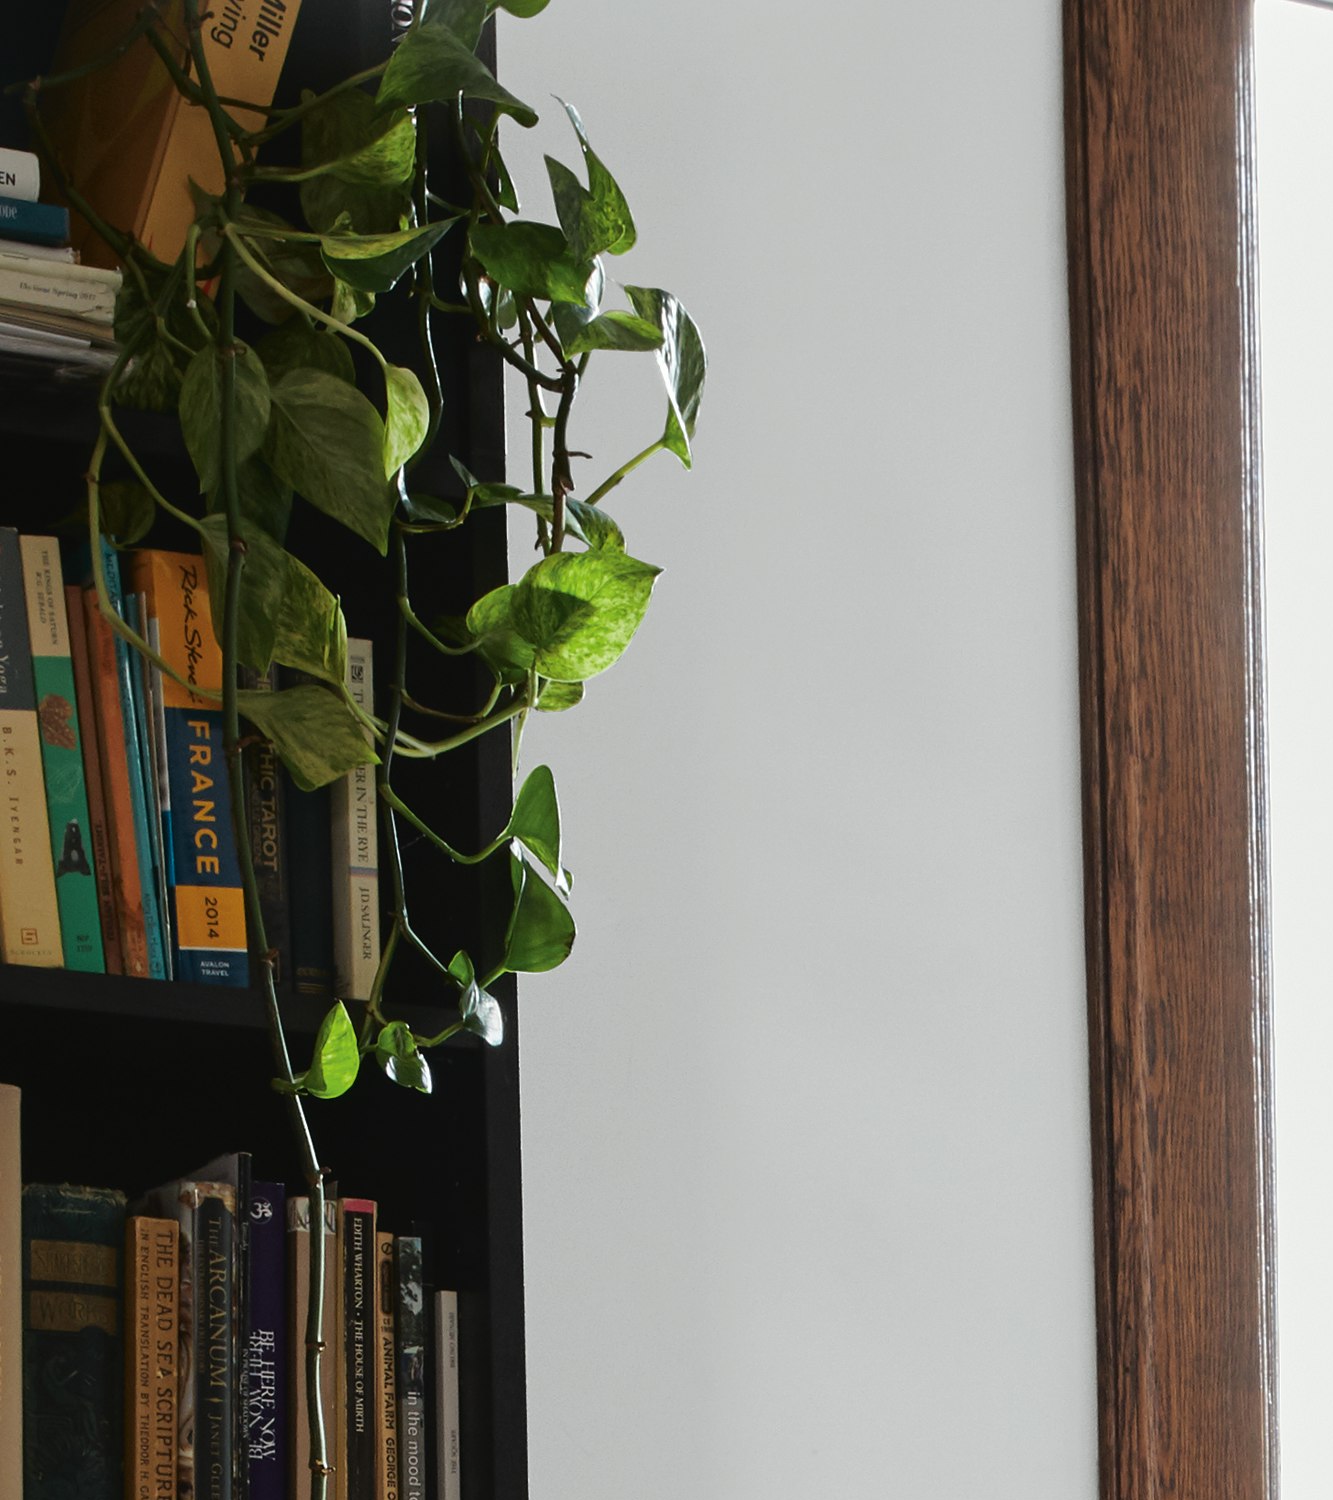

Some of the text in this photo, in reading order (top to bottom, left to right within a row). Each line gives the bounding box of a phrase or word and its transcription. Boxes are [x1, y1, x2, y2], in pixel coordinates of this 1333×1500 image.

[179, 563, 198, 626] Rick
[186, 719, 221, 876] FRANCE
[356, 788, 368, 803] IN
[357, 805, 369, 835] THE
[9, 796, 24, 866] IYENGAR
[261, 795, 279, 873] TAROT
[357, 836, 370, 864] RYE
[204, 895, 219, 939] 2014
[360, 904, 373, 961] SALINGER
[200, 960, 230, 969] AVALON
[200, 968, 229, 978] TRAVEL
[139, 1244, 151, 1301] ENGLISH
[155, 1230, 174, 1269] THE
[353, 1217, 364, 1310] EDITH WHARTON
[155, 1277, 174, 1333] DEAD
[207, 1215, 229, 1389] THE ARCANUM
[139, 1306, 151, 1388] TRANSLATION
[155, 1340, 174, 1379] SEA
[382, 1336, 395, 1390] ANIMAL
[139, 1392, 150, 1407] BY
[258, 1328, 277, 1461] BE HERE NOW
[354, 1319, 365, 1433] THE HOUSE OF MIRTH
[407, 1389, 420, 1407] in
[207, 1412, 222, 1457] JANET
[384, 1391, 396, 1431] FARM
[407, 1409, 421, 1437] the
[139, 1413, 151, 1467] THEODOR
[385, 1436, 396, 1489] GEORGE
[407, 1440, 422, 1487] mood
